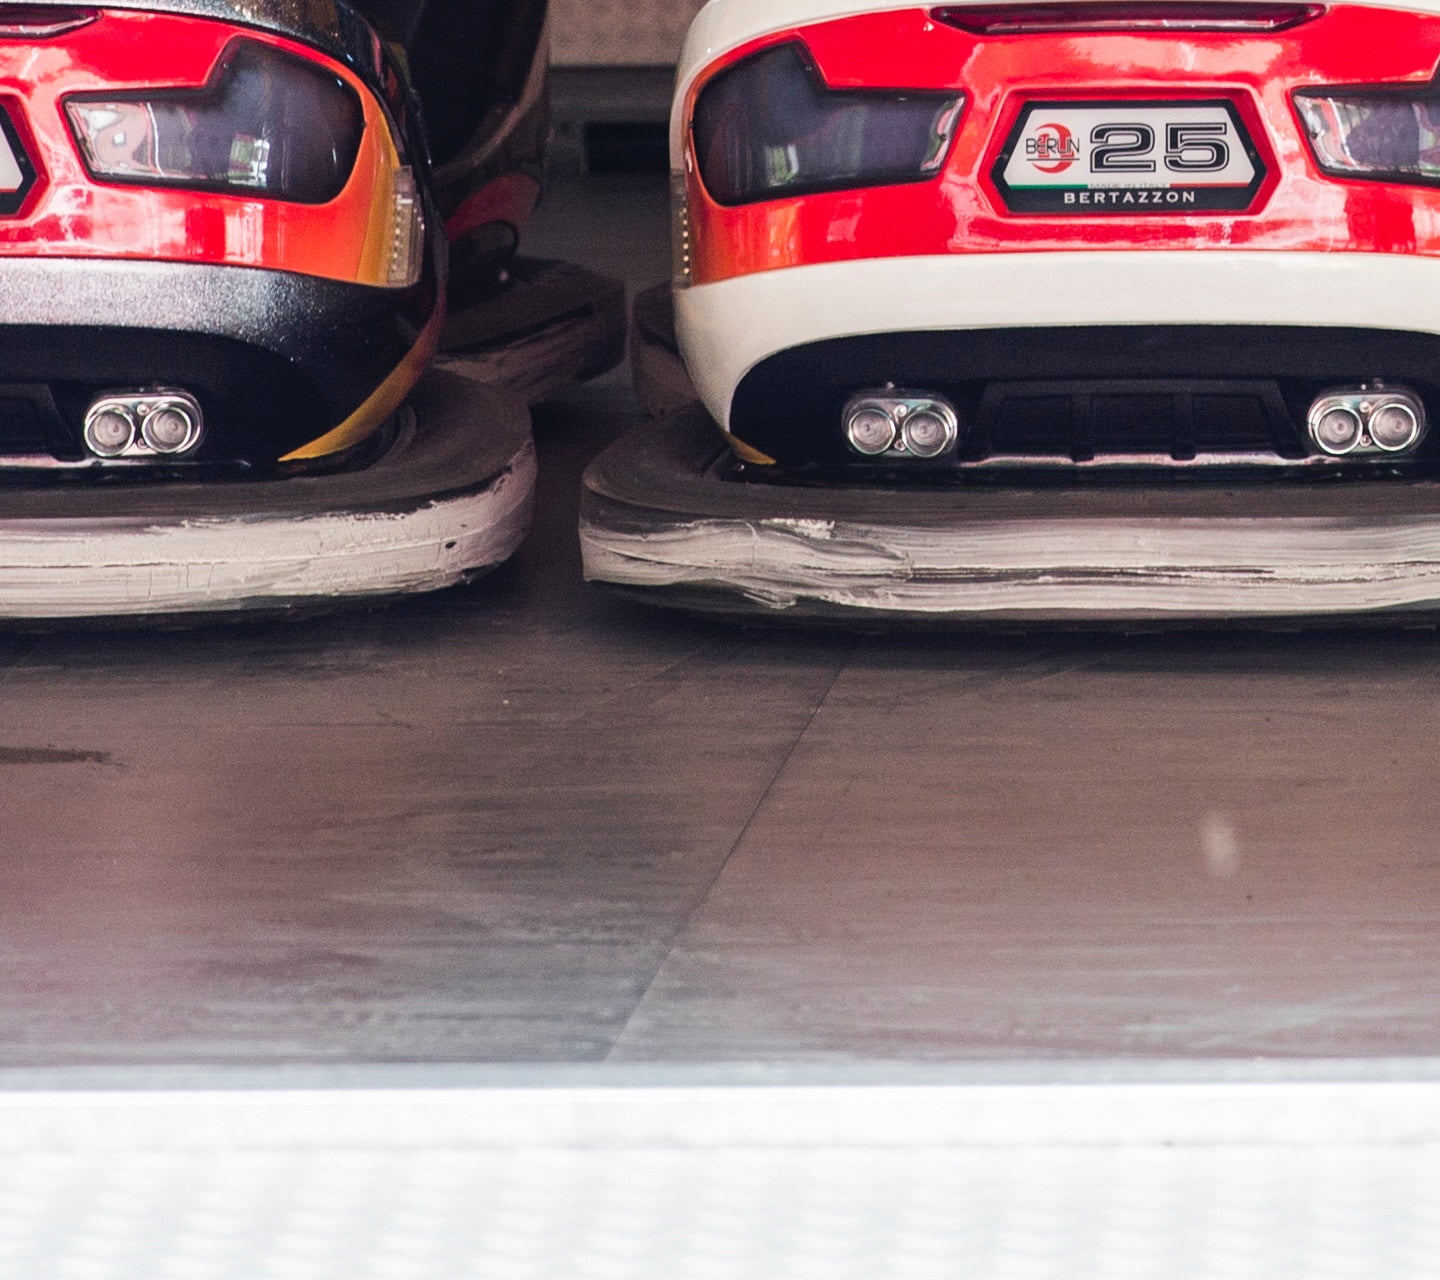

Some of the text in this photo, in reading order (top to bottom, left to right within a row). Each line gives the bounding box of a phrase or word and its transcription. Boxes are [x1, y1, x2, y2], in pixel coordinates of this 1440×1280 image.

[1025, 122, 1230, 173] BERLIN 25
[1063, 191, 1195, 204] BERTAZZON
